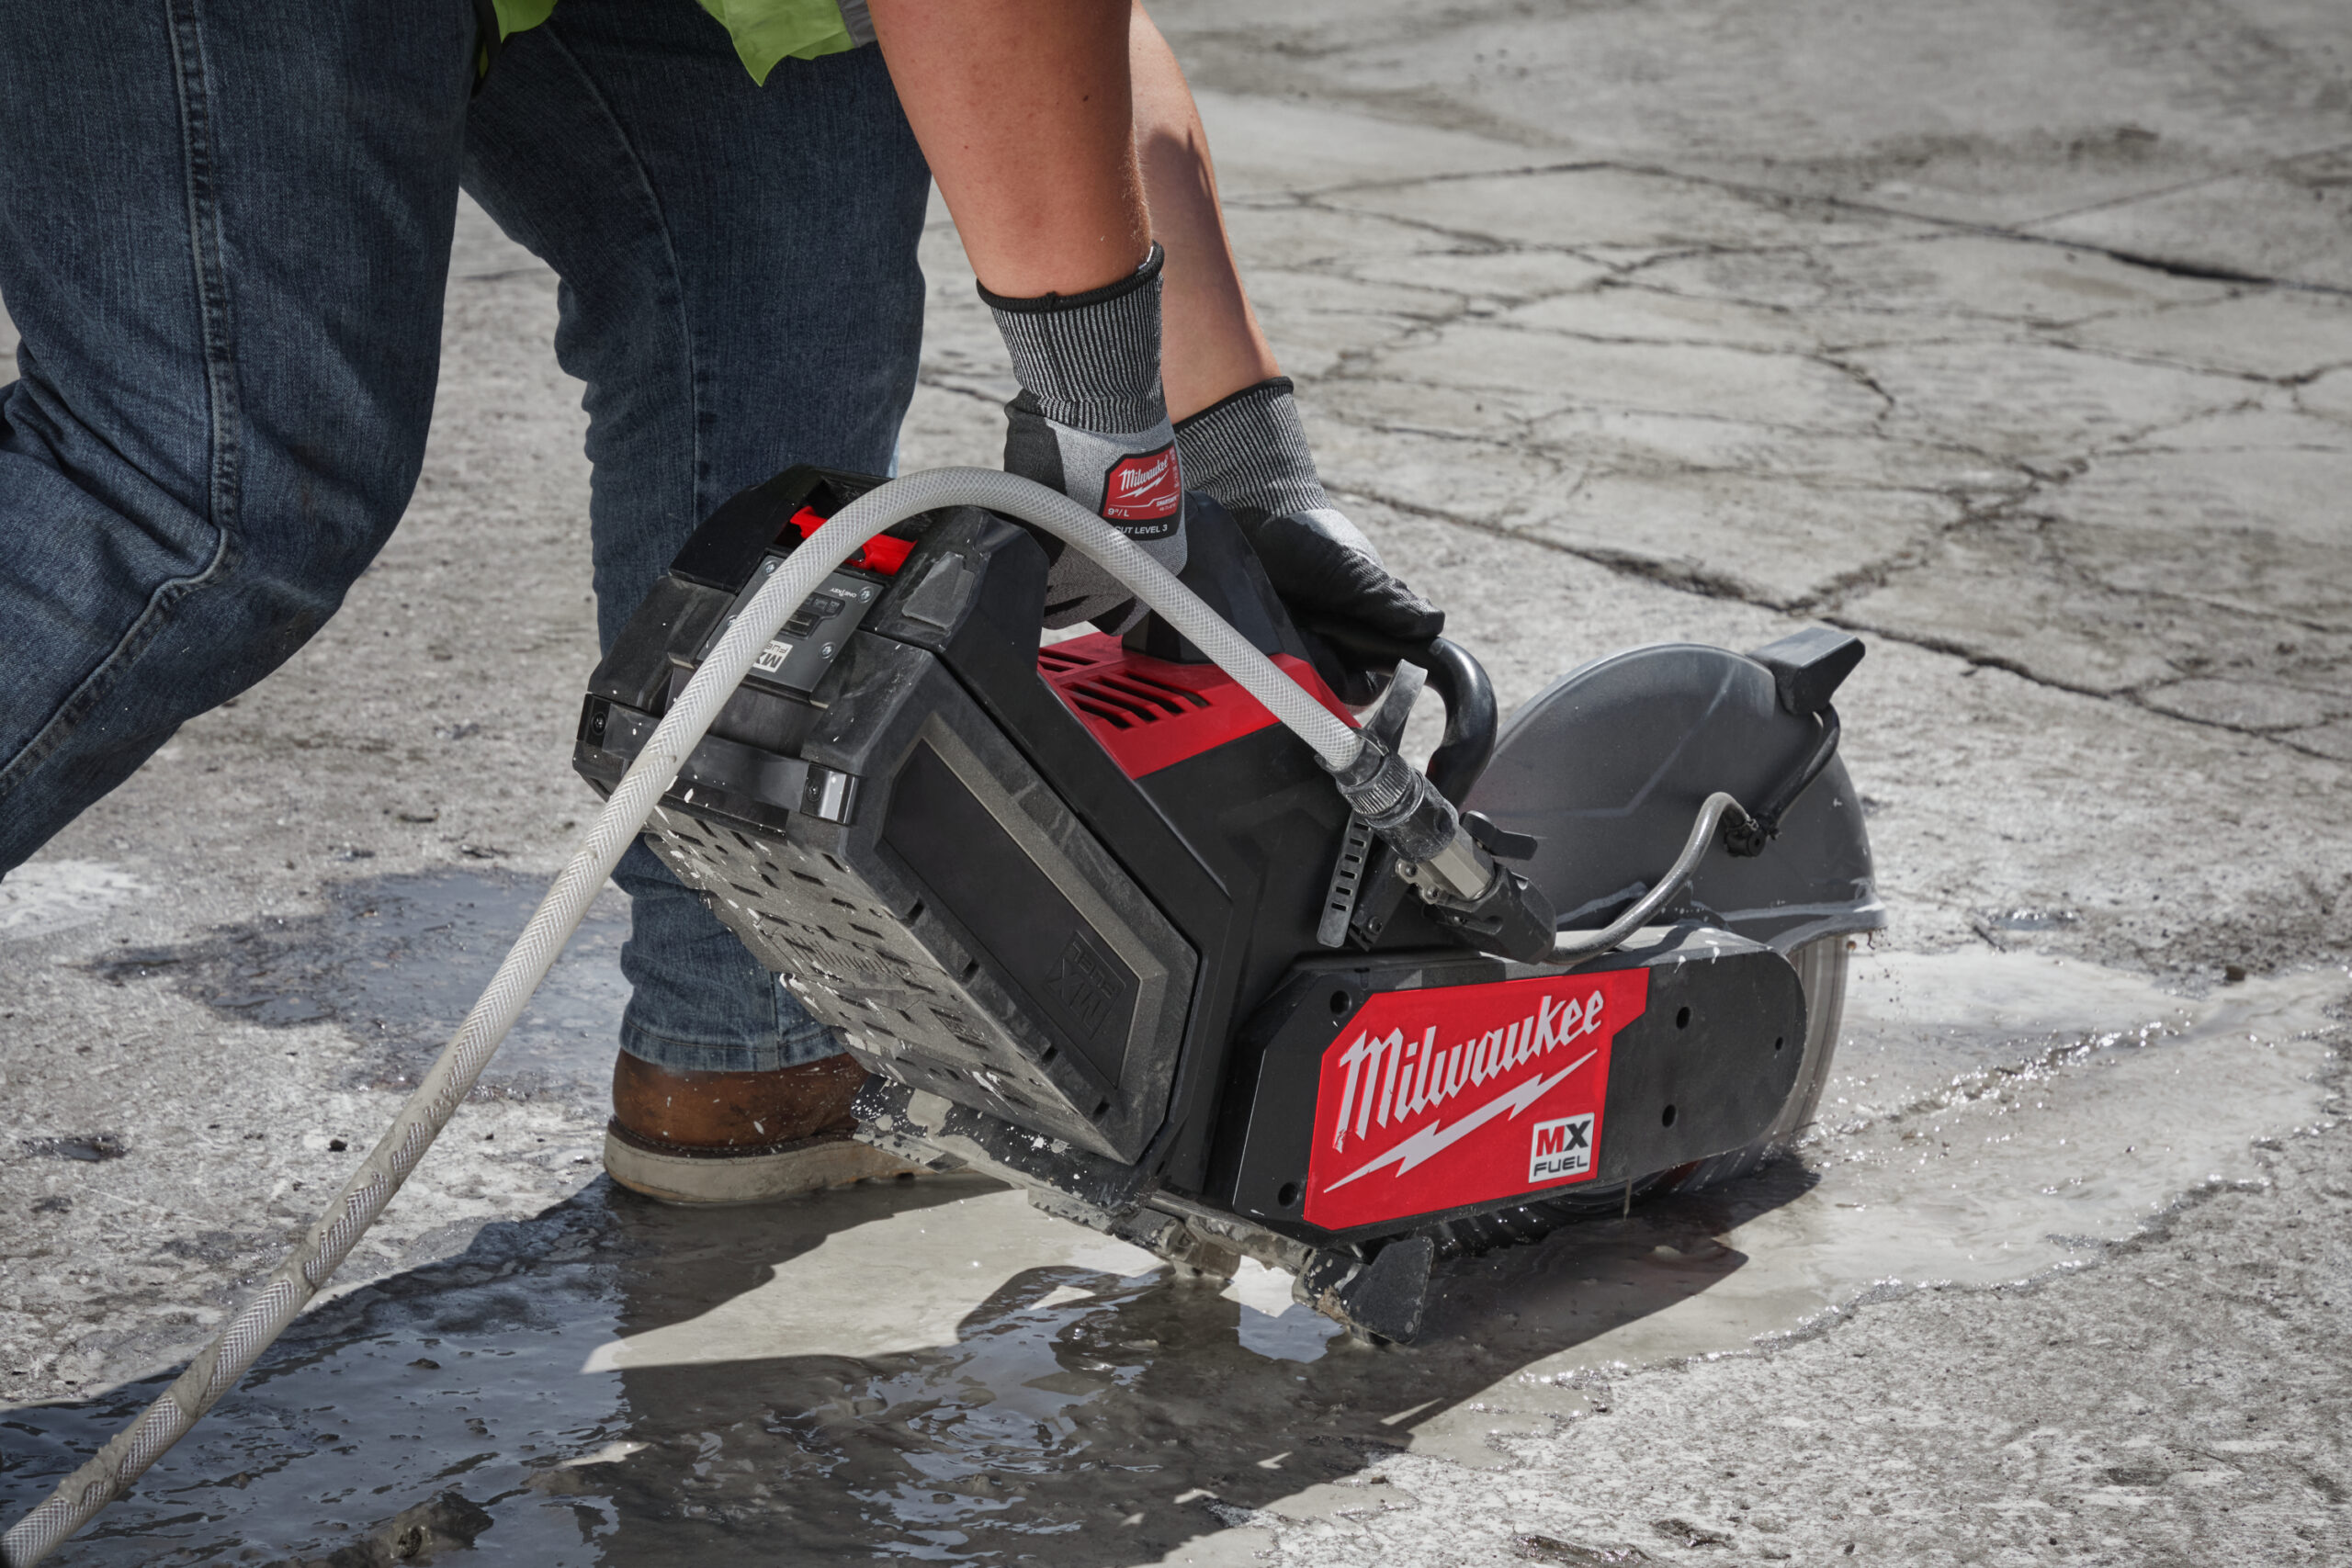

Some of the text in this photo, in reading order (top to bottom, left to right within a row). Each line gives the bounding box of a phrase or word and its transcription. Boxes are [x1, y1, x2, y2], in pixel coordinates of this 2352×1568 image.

[1118, 458, 1169, 491] Milwaukee
[1135, 525, 1160, 535] LEVEL
[1162, 524, 1168, 532] 3
[1071, 940, 1117, 1000] FUEL
[1046, 956, 1108, 1032] MX
[1333, 989, 1604, 1154] Milwaukee
[1535, 1120, 1595, 1157] MX
[1533, 1156, 1589, 1177] FUEL
